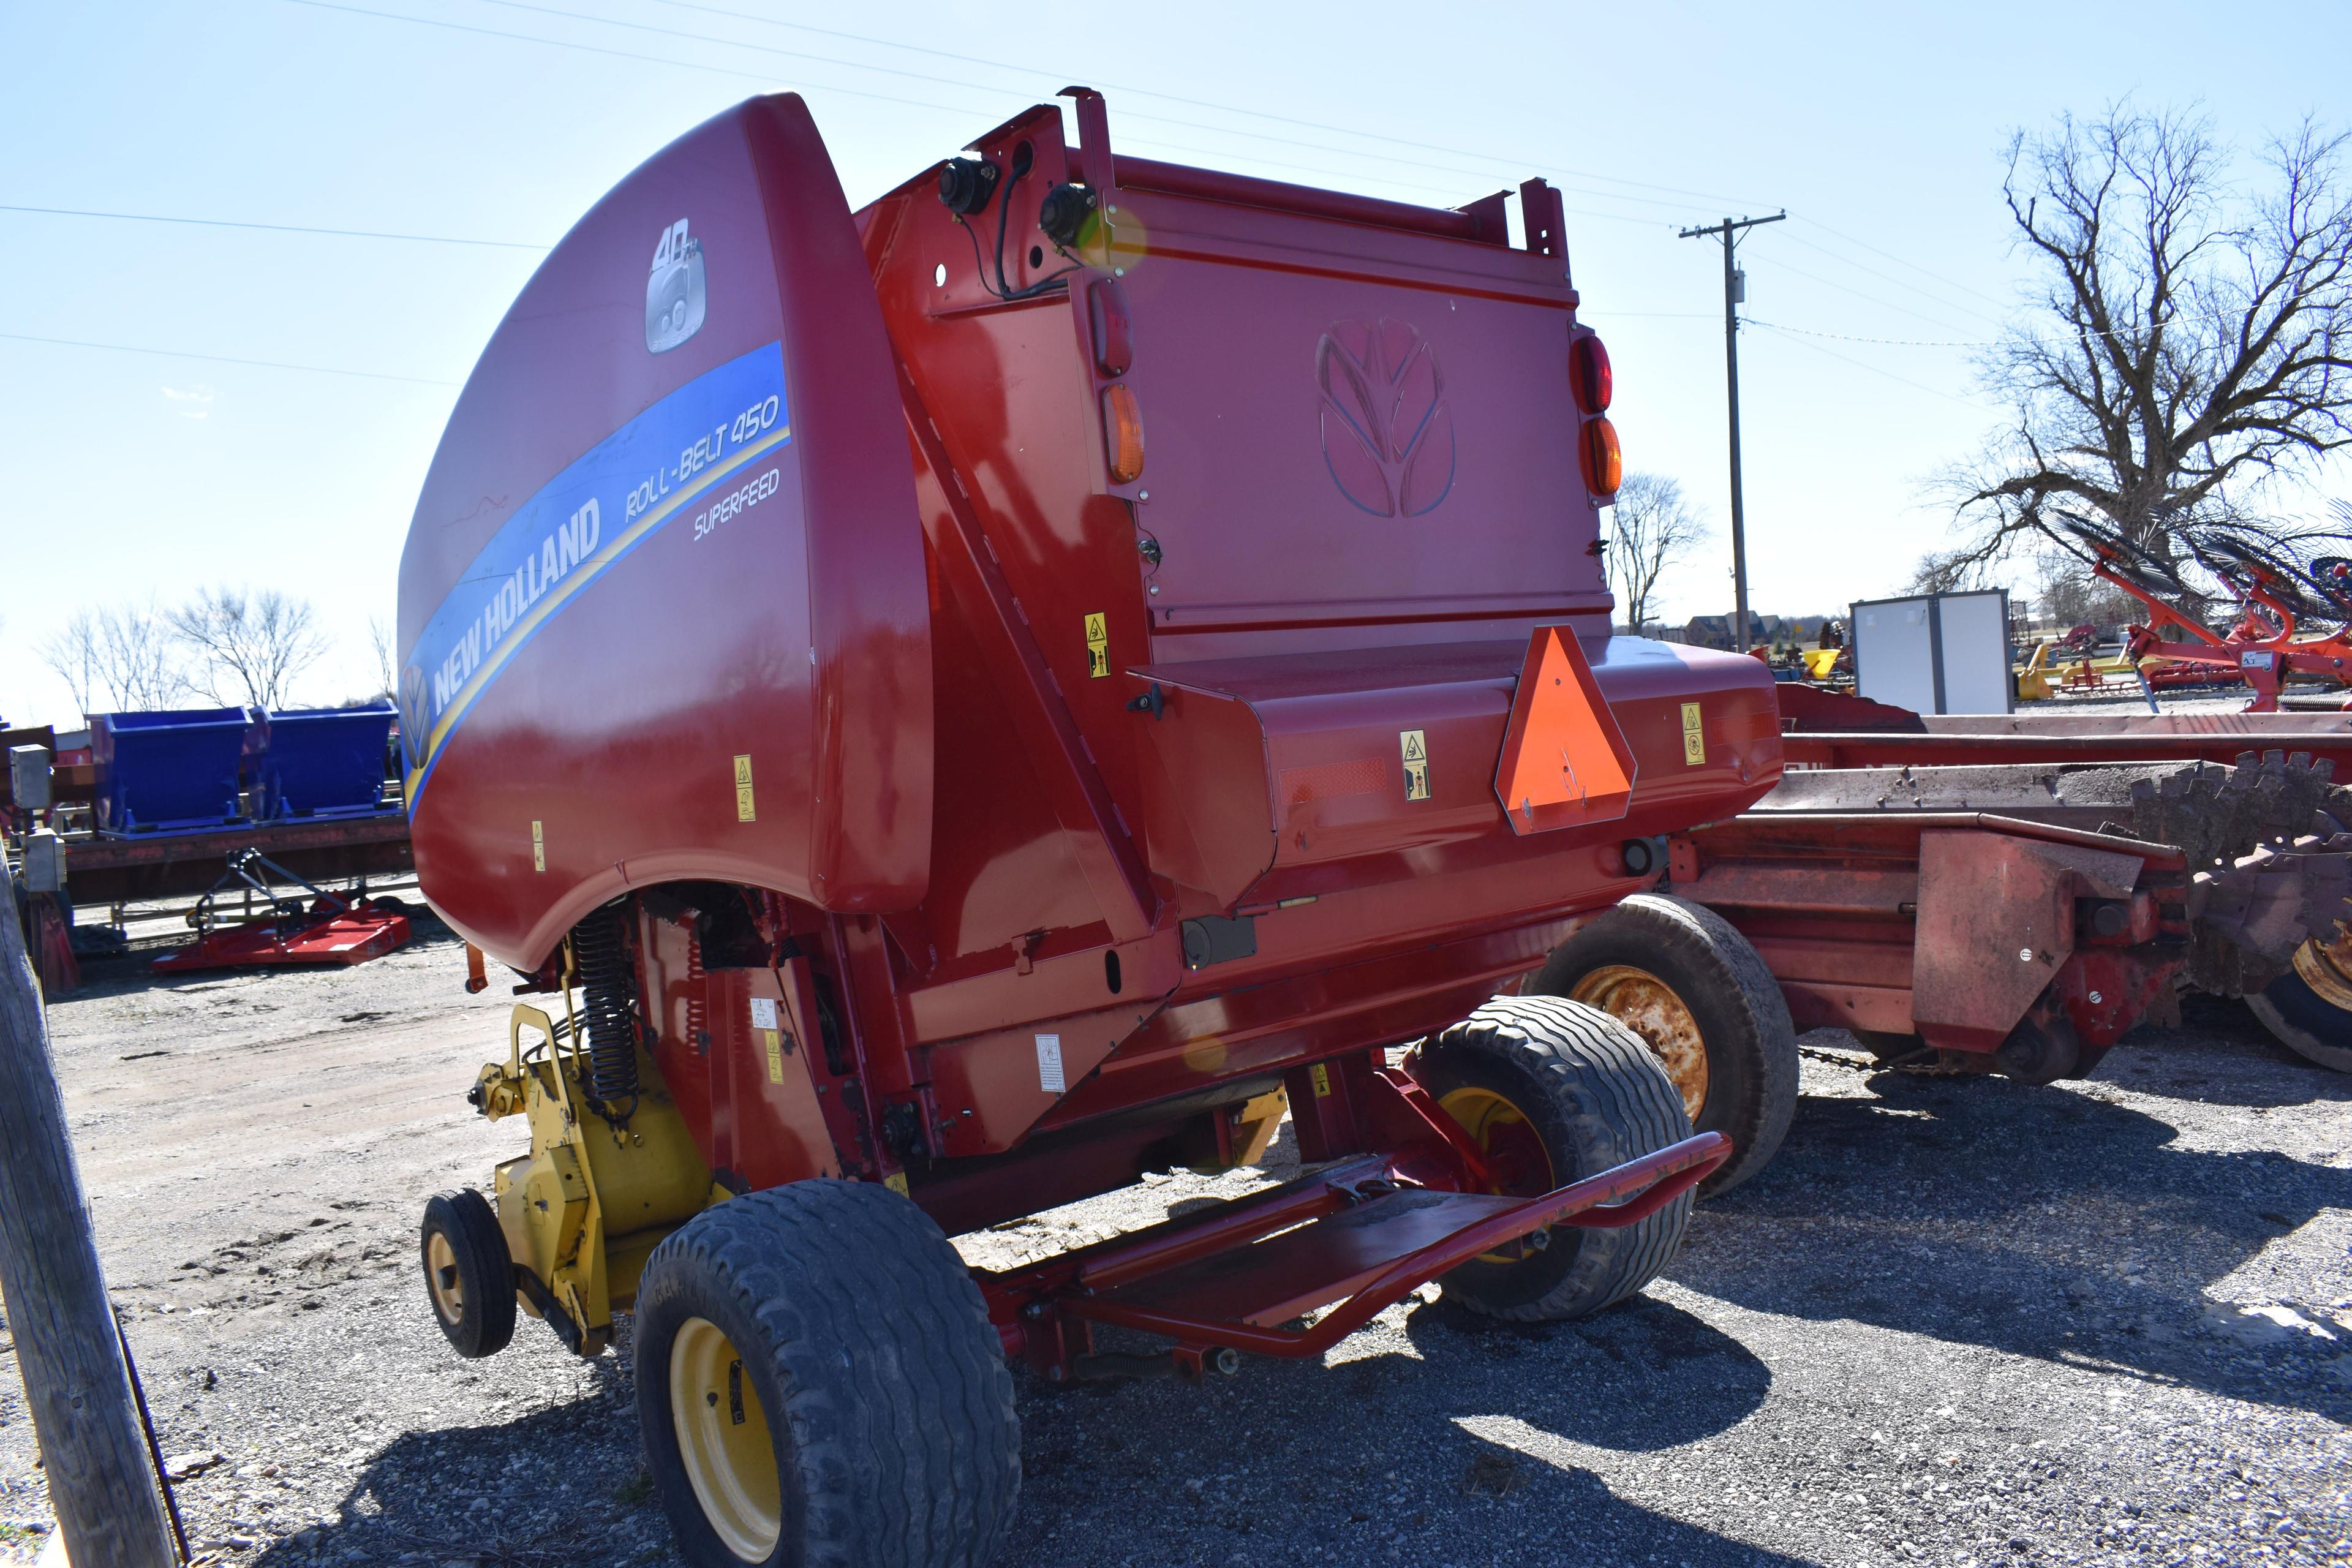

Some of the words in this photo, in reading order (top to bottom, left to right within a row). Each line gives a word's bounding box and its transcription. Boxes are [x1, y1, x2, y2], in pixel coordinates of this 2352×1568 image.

[731, 394, 780, 444] 450
[694, 468, 780, 542] SUPERFEED
[434, 617, 481, 717] NEW
[484, 497, 600, 654] HOLLAND
